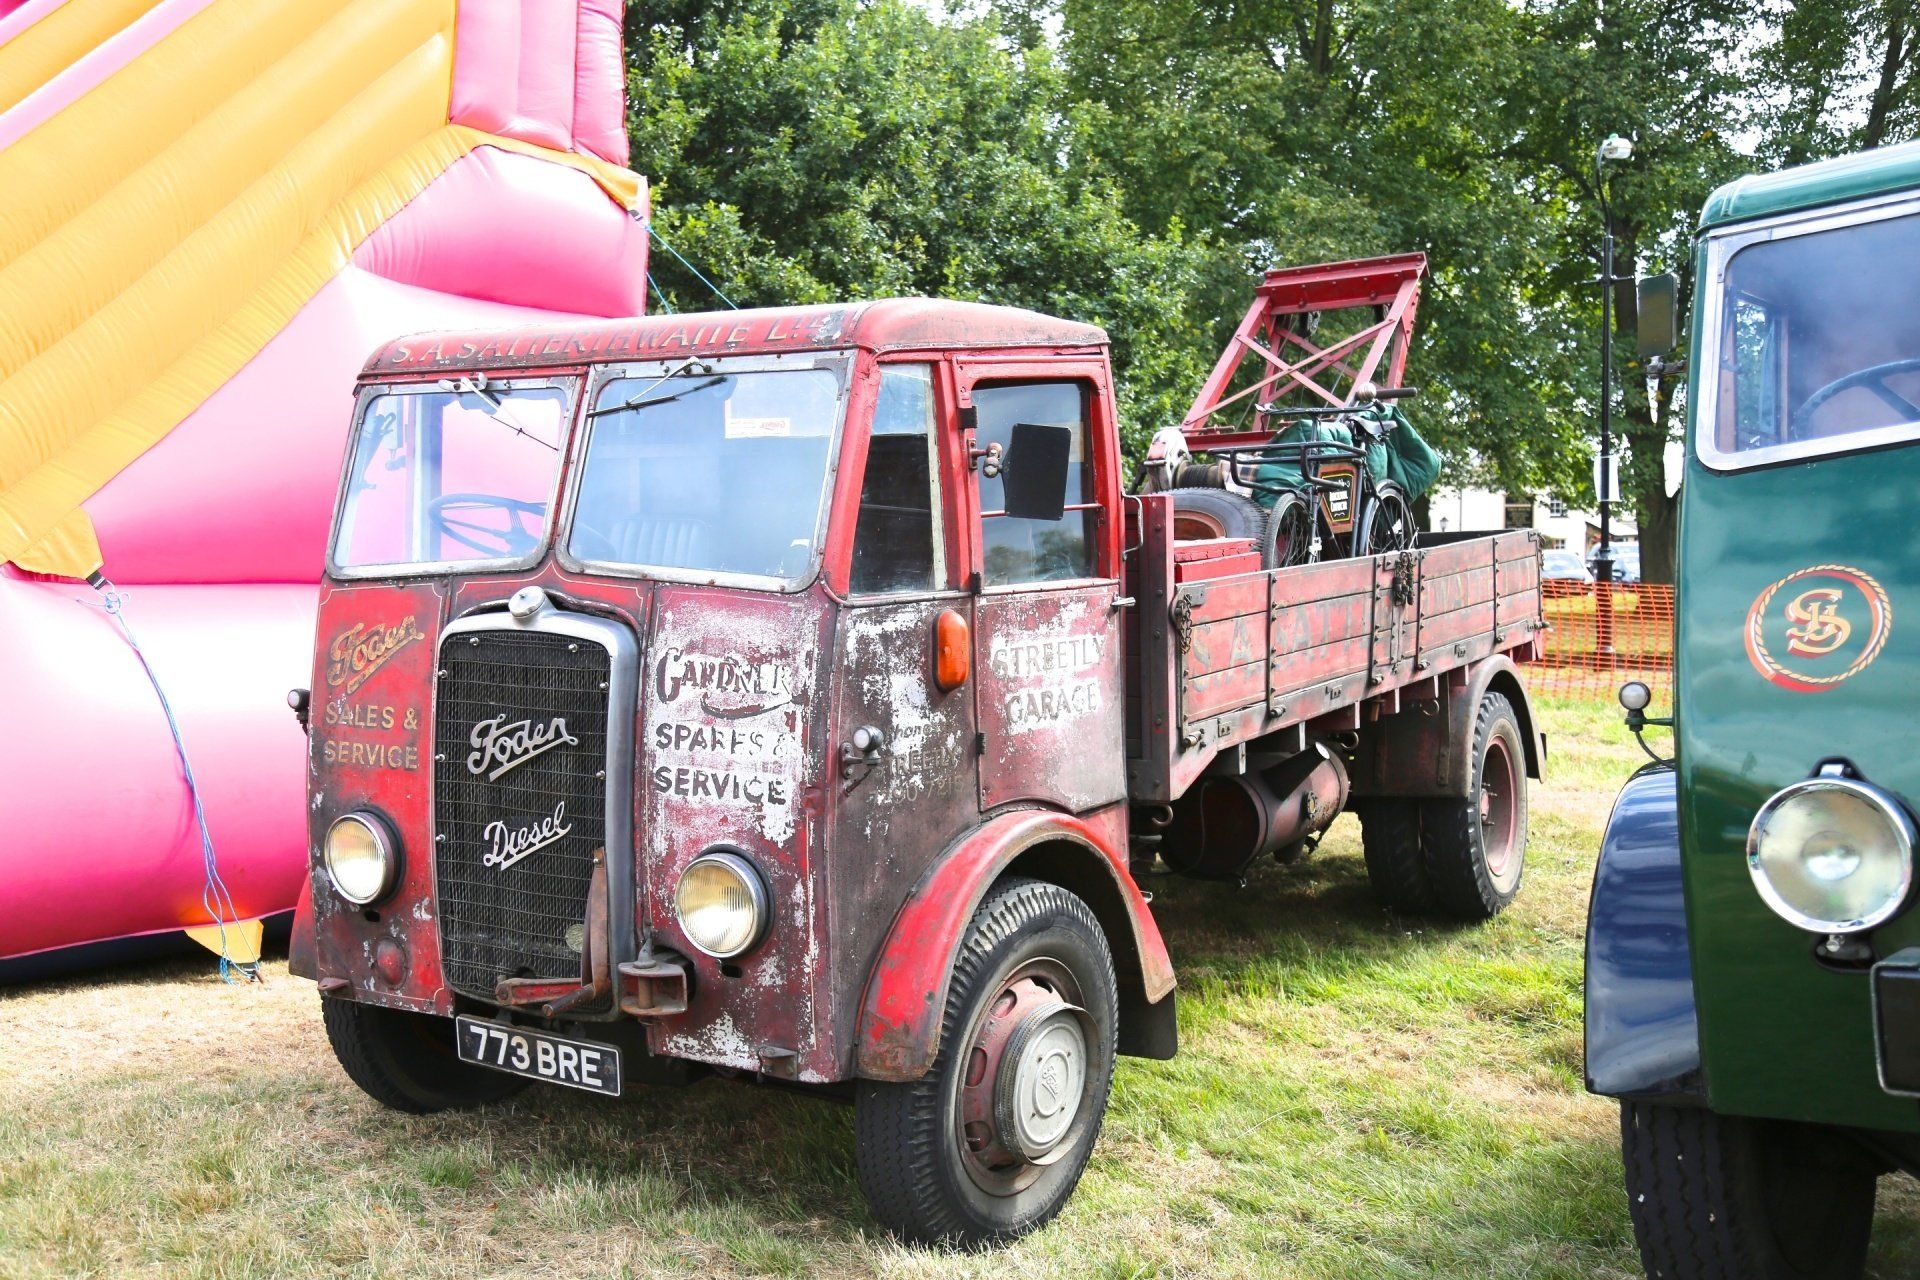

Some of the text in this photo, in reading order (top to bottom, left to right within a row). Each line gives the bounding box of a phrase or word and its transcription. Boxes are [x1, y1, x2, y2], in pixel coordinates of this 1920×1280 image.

[992, 637, 1106, 680] STREETLY
[326, 701, 418, 730] SALES &
[1005, 682, 1097, 724] GARAGE
[324, 740, 419, 769] SERVICE
[467, 713, 579, 783] Foden
[655, 766, 786, 805] SERVICE
[483, 801, 572, 871] Diesel
[470, 1025, 602, 1087] 773 BRE
